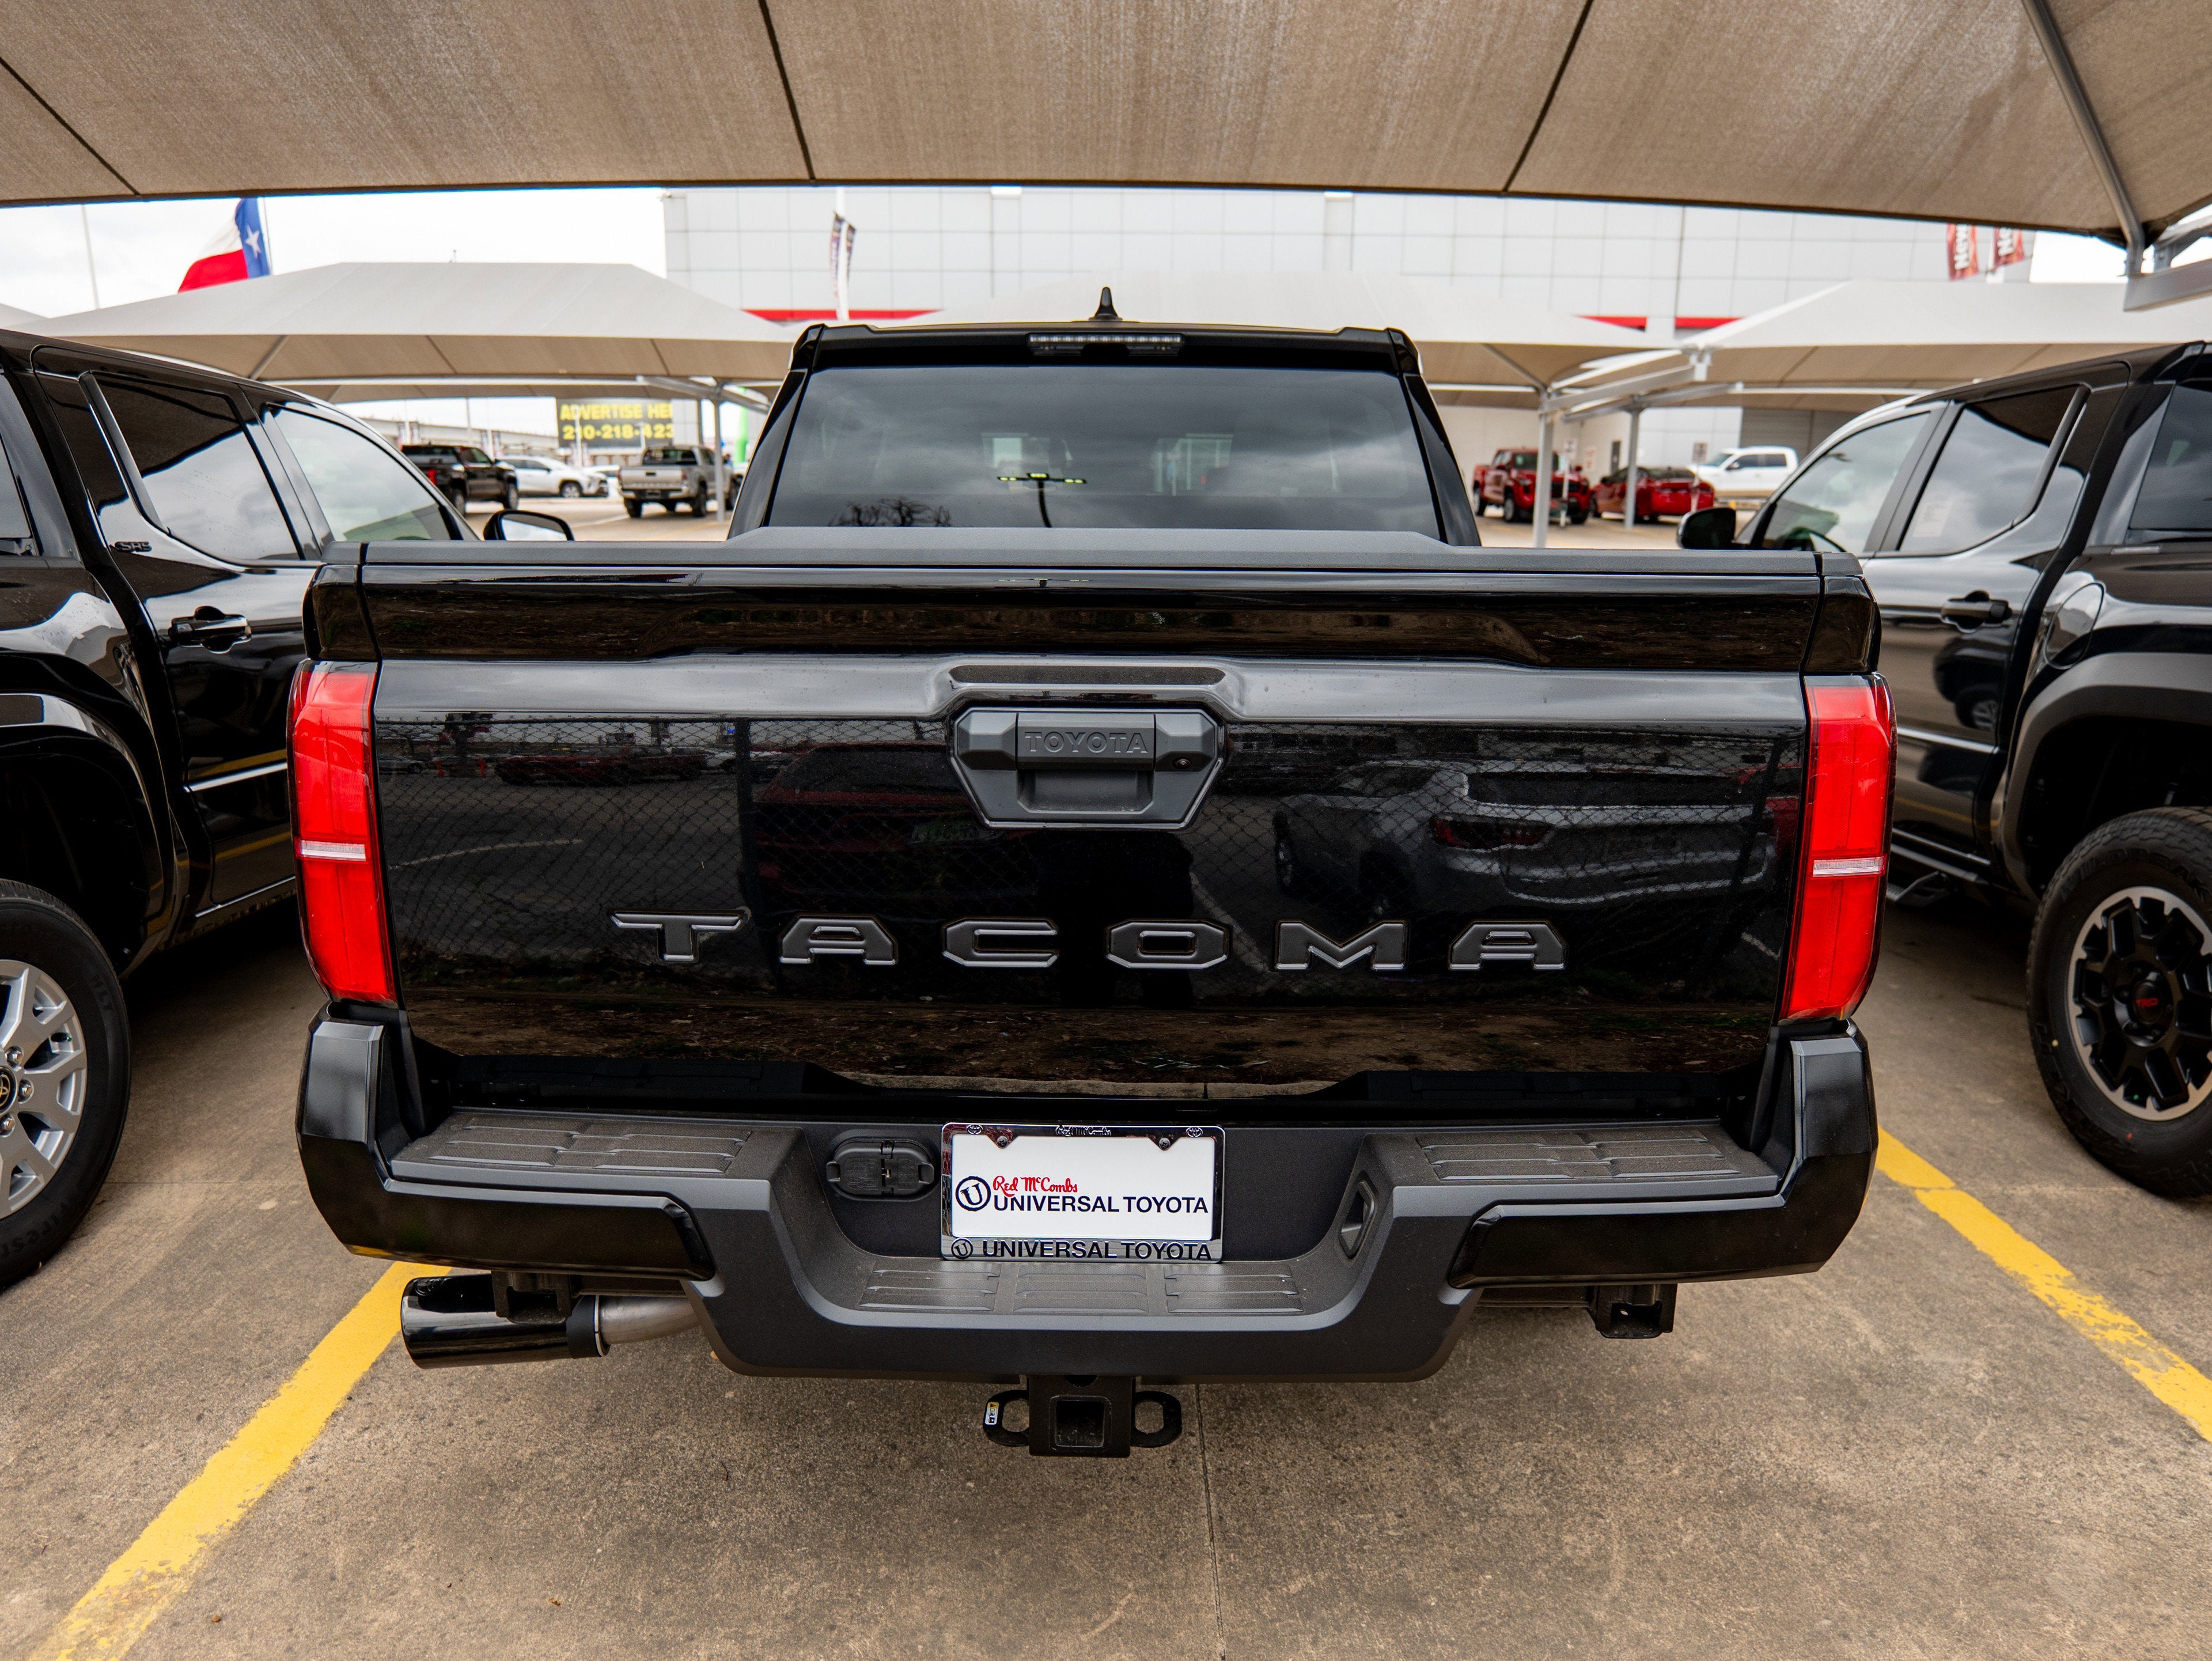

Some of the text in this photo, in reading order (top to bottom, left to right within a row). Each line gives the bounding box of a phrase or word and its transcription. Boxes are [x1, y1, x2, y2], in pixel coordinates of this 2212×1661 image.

[560, 403, 642, 420] ADVERTISE
[115, 542, 151, 551] SR5
[1024, 731, 1148, 754] TOYOTA
[609, 911, 1569, 970] TACOMA
[1055, 1125, 1073, 1137] Red
[993, 1176, 1078, 1197] Red McCombs
[994, 1195, 1209, 1213] UNIVERSAL TOYOTA
[983, 1239, 1212, 1260] UNIVERSAL TOYOTA
